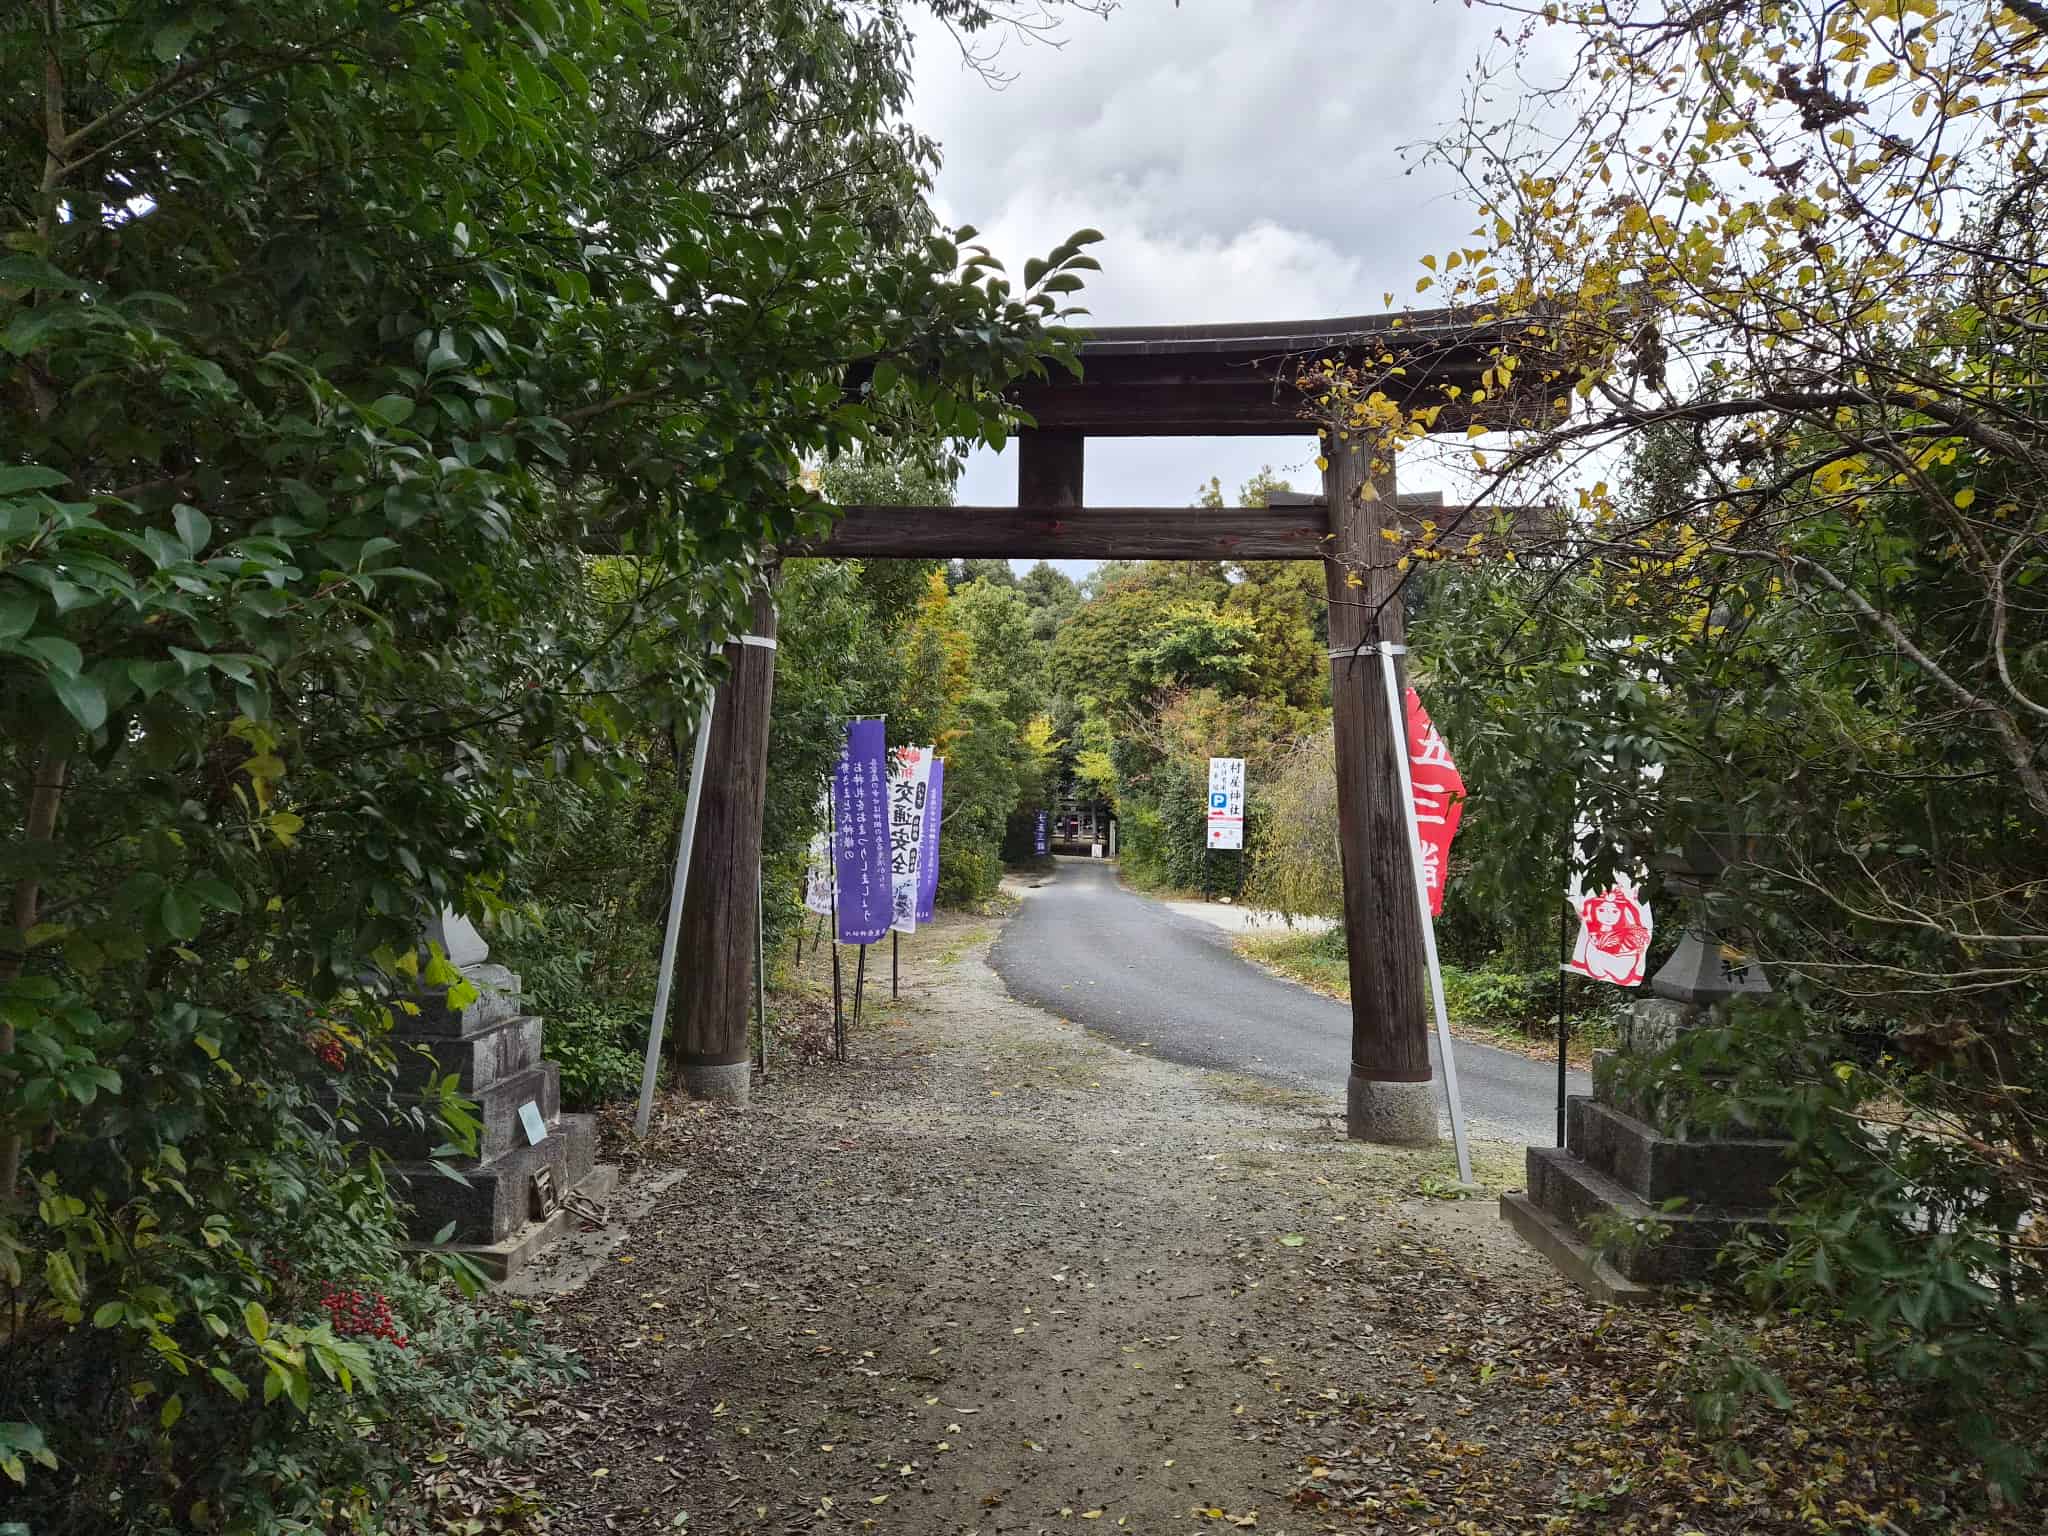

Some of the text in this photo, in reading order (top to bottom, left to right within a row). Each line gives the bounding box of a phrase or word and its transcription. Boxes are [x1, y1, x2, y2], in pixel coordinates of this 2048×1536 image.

[890, 780, 915, 876] 交通安全
[1213, 795, 1225, 807] P
